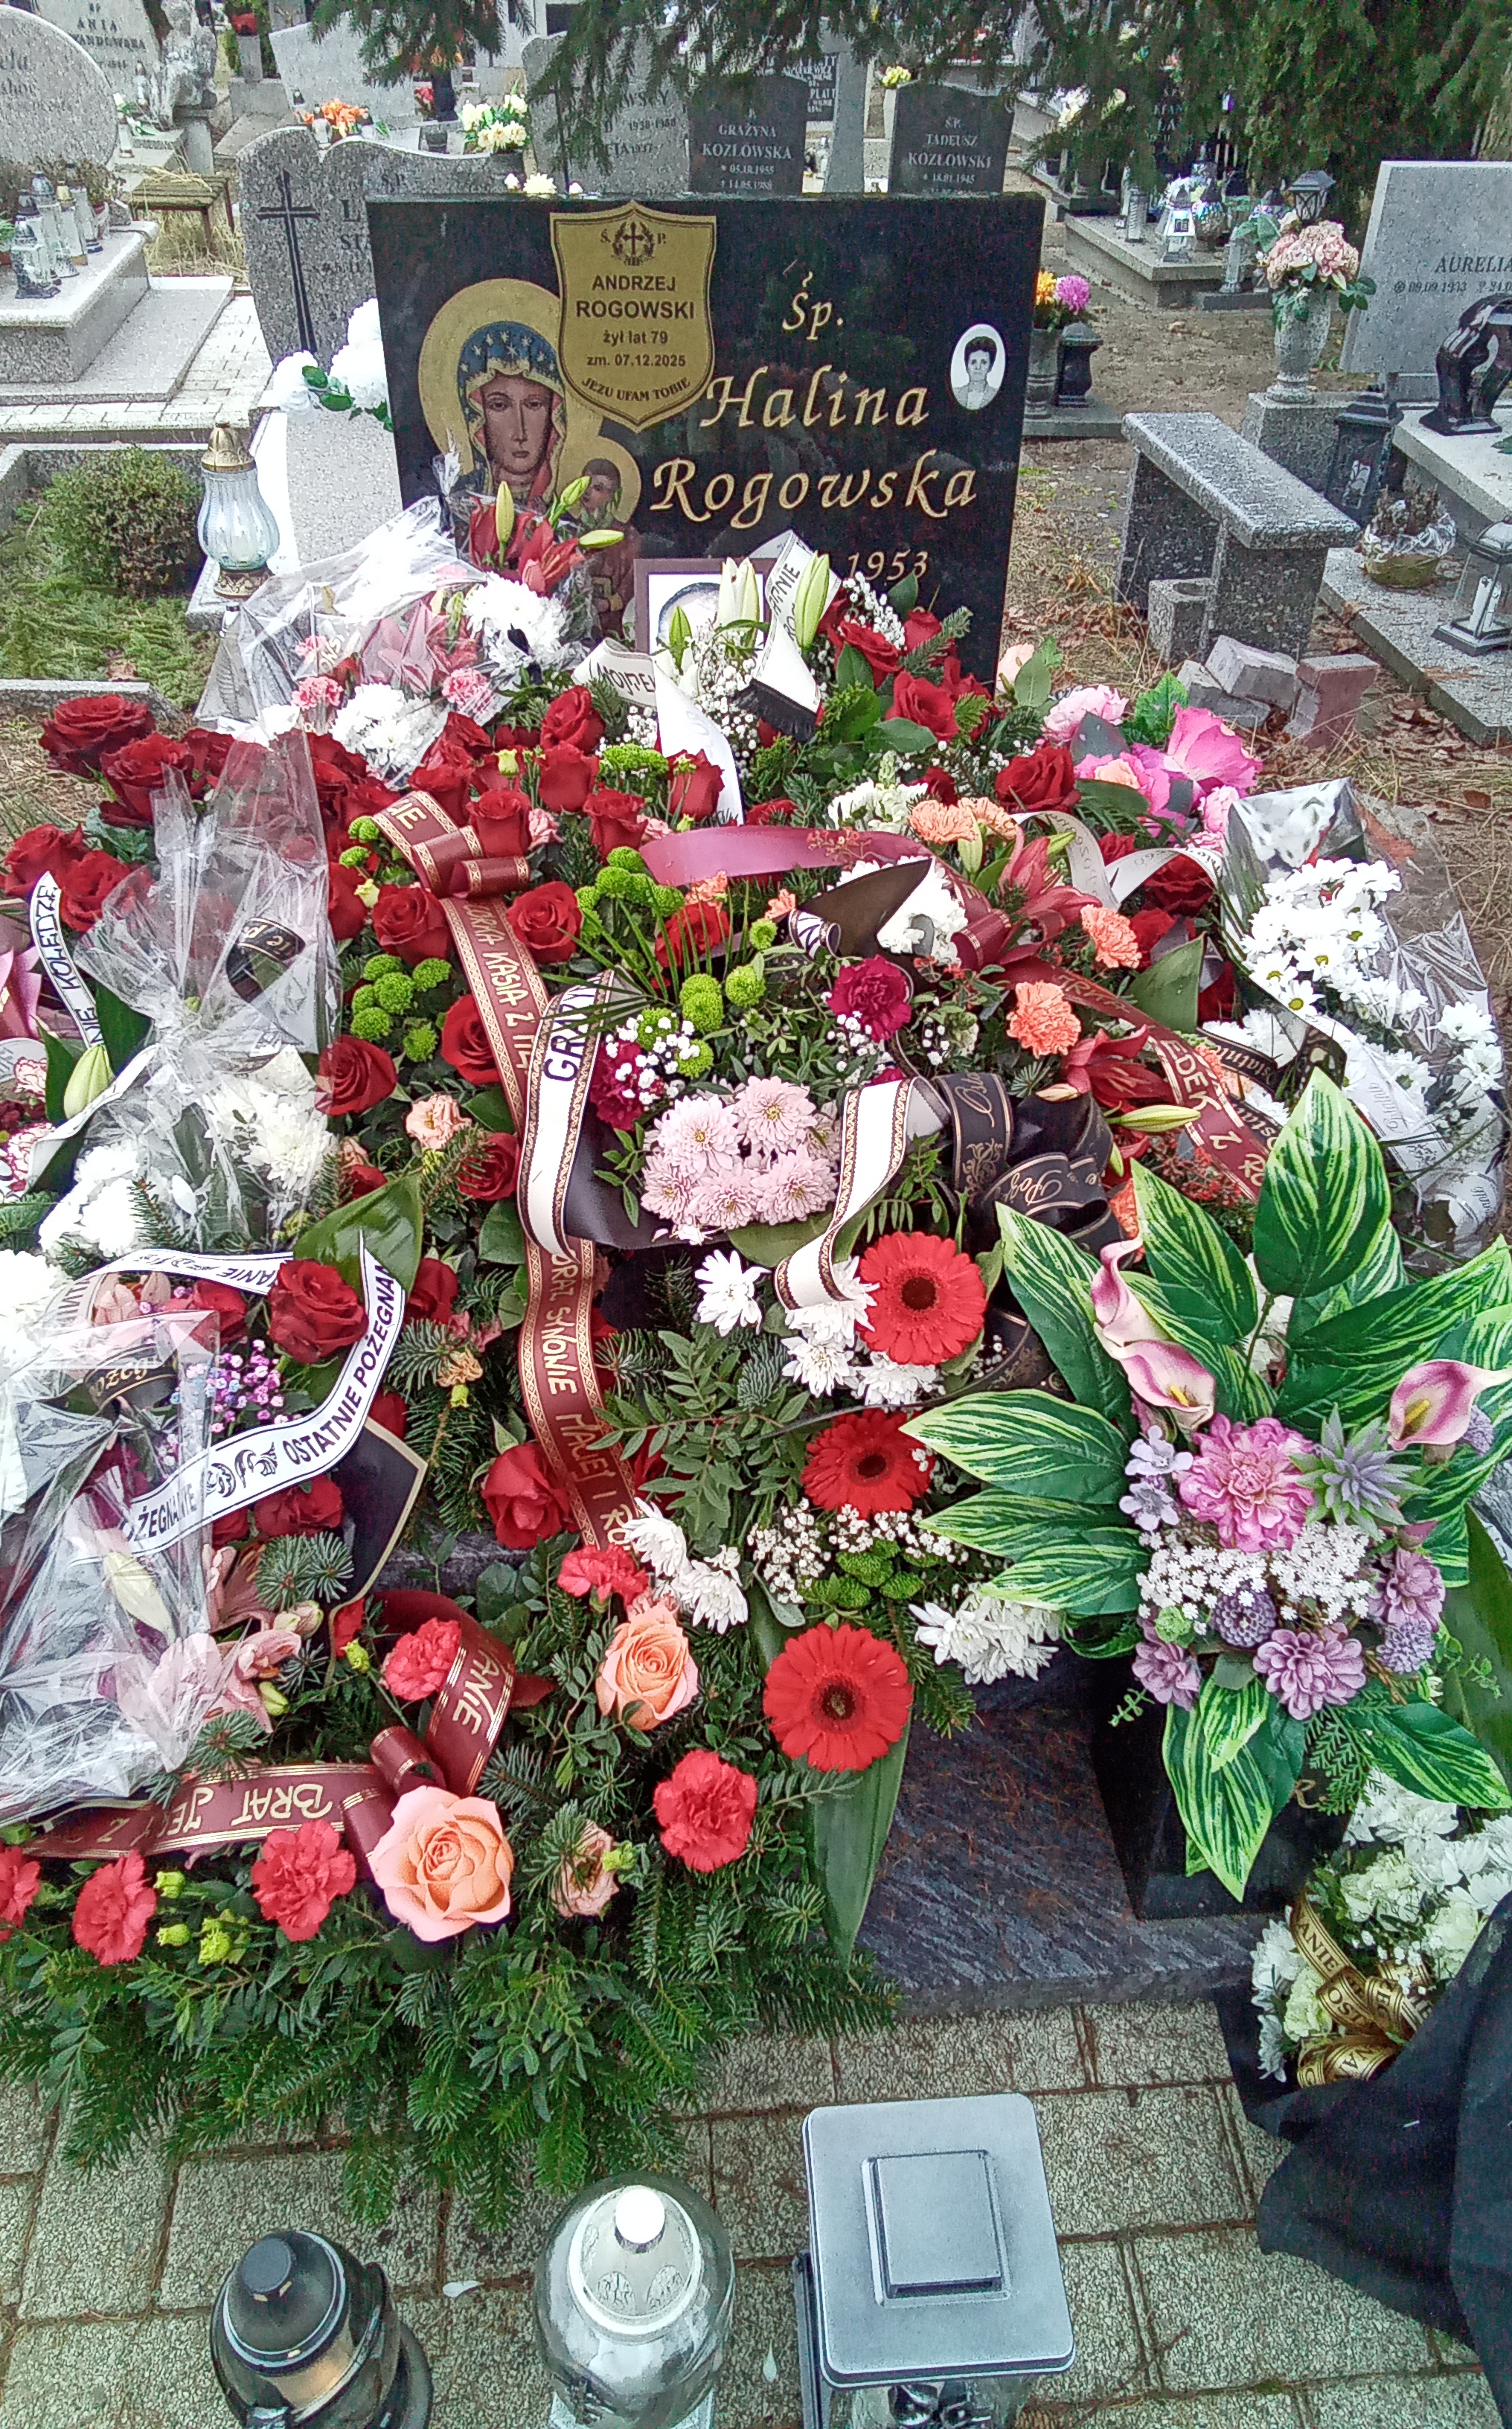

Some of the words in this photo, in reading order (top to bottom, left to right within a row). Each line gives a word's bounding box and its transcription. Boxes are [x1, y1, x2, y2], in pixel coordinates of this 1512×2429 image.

[718, 122, 777, 138] GRAŻYNA
[926, 133, 978, 147] TADEUSZ
[592, 275, 676, 292] ANDRZEJ
[576, 300, 695, 320] ROGOWSKI
[629, 330, 647, 345] lat
[651, 330, 669, 345] 79
[586, 356, 610, 366] zm.
[615, 354, 686, 367] 07.12.2025
[581, 377, 613, 398] JEZU
[616, 389, 650, 402] UFAM
[652, 377, 691, 400] TOBIE
[699, 364, 930, 429] Halina
[650, 449, 977, 530] Rogowska
[848, 548, 929, 580] 1953
[482, 951, 530, 1007] KASIA
[1160, 1039, 1223, 1113] EDEK
[282, 1385, 362, 1465] OSTATNIE
[231, 1783, 334, 1826] BRAT
